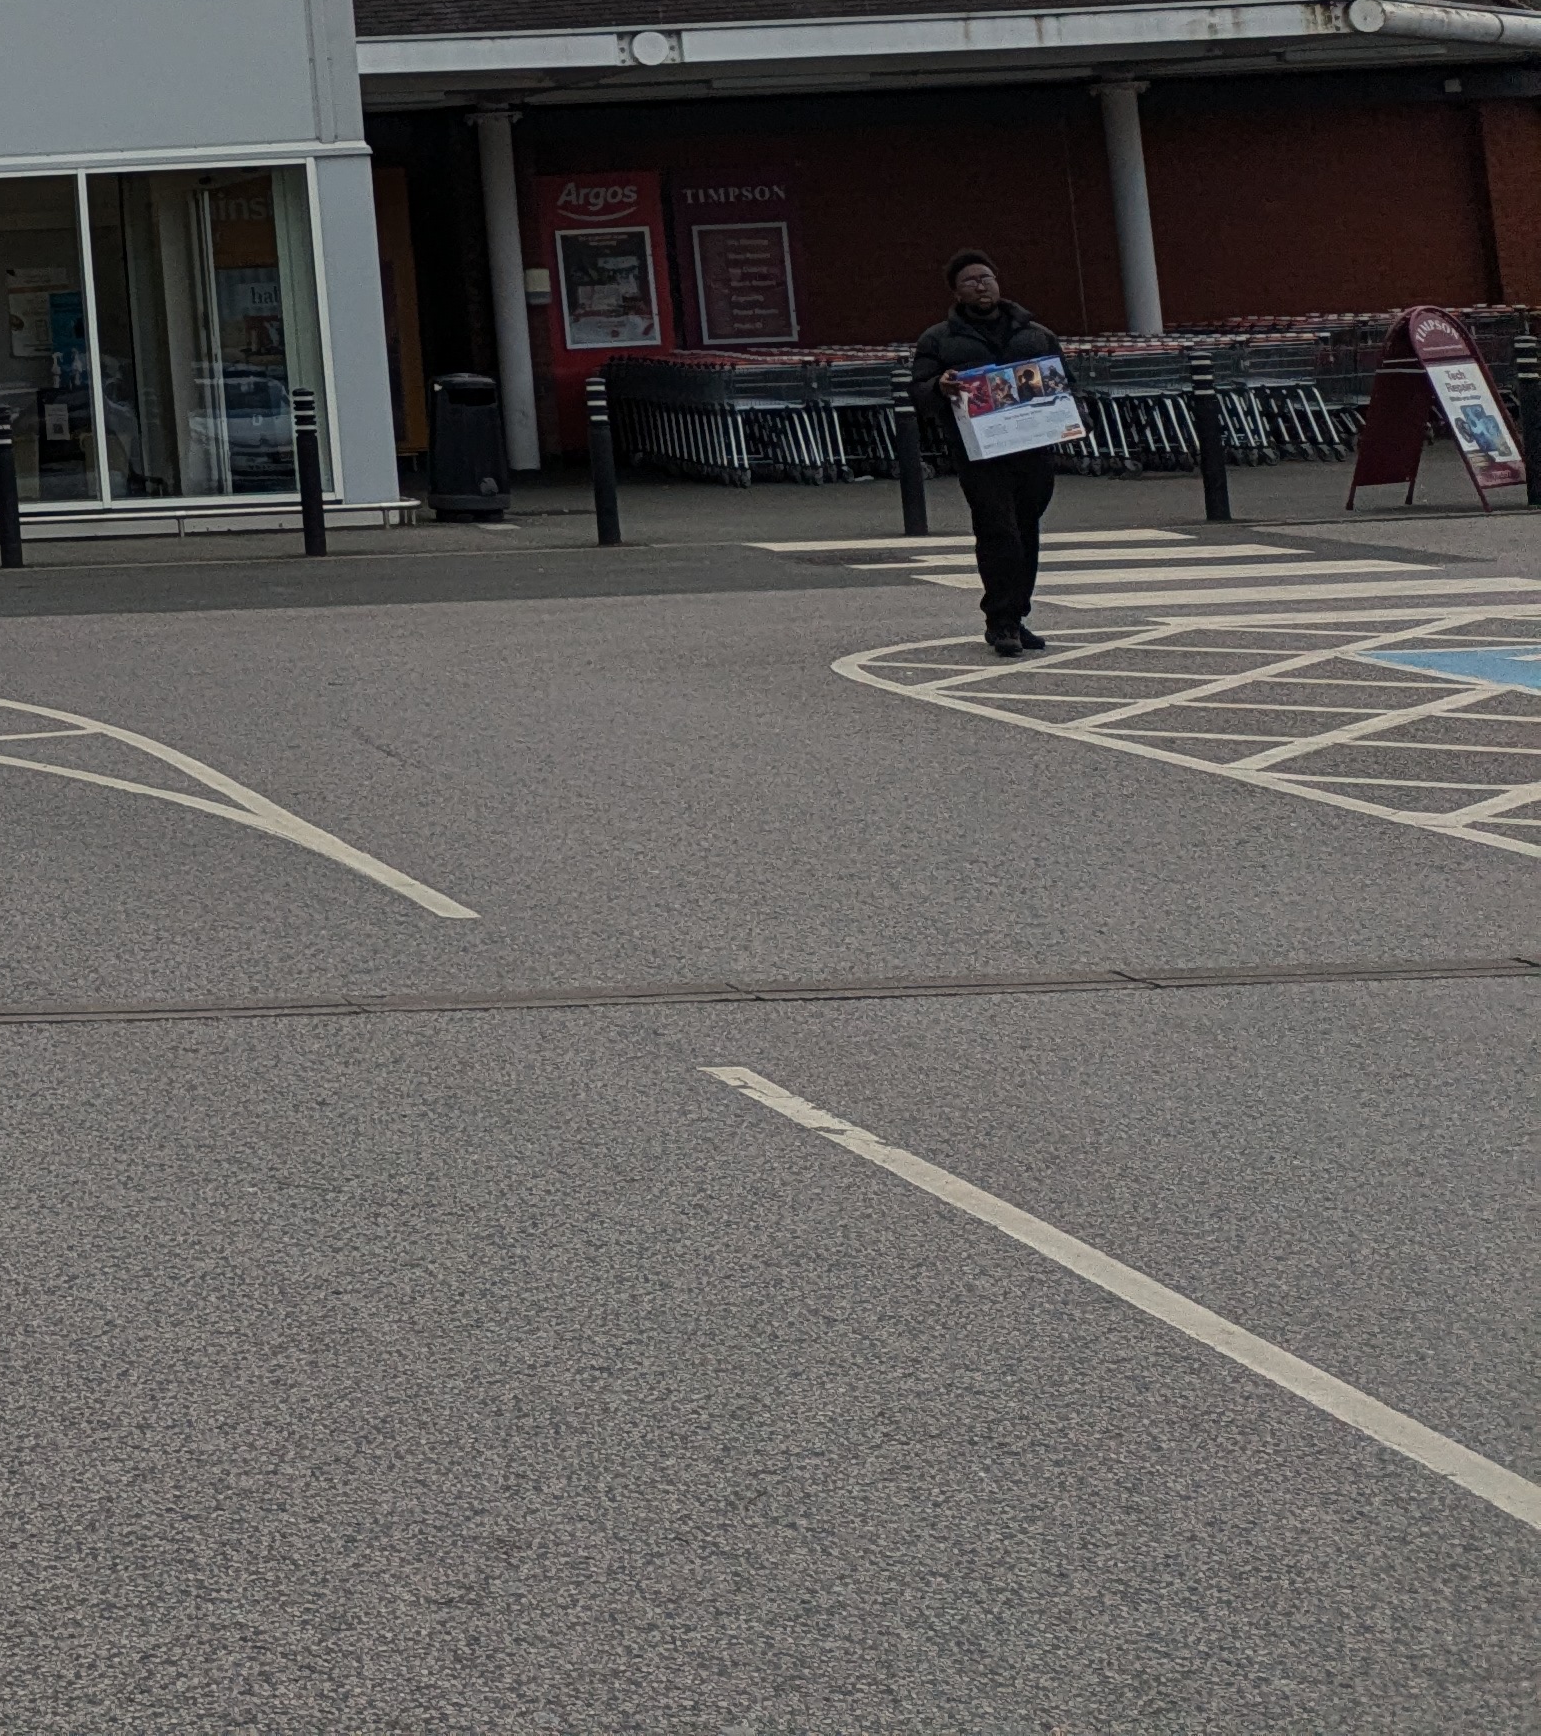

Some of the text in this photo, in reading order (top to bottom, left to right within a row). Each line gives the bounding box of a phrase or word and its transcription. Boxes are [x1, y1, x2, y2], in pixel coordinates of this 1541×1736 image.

[557, 182, 637, 210] Argos
[682, 184, 787, 204] TIMPSON
[1415, 319, 1459, 342] TIMPSON
[1444, 369, 1466, 380] Tech
[1444, 381, 1477, 395] Repairs
